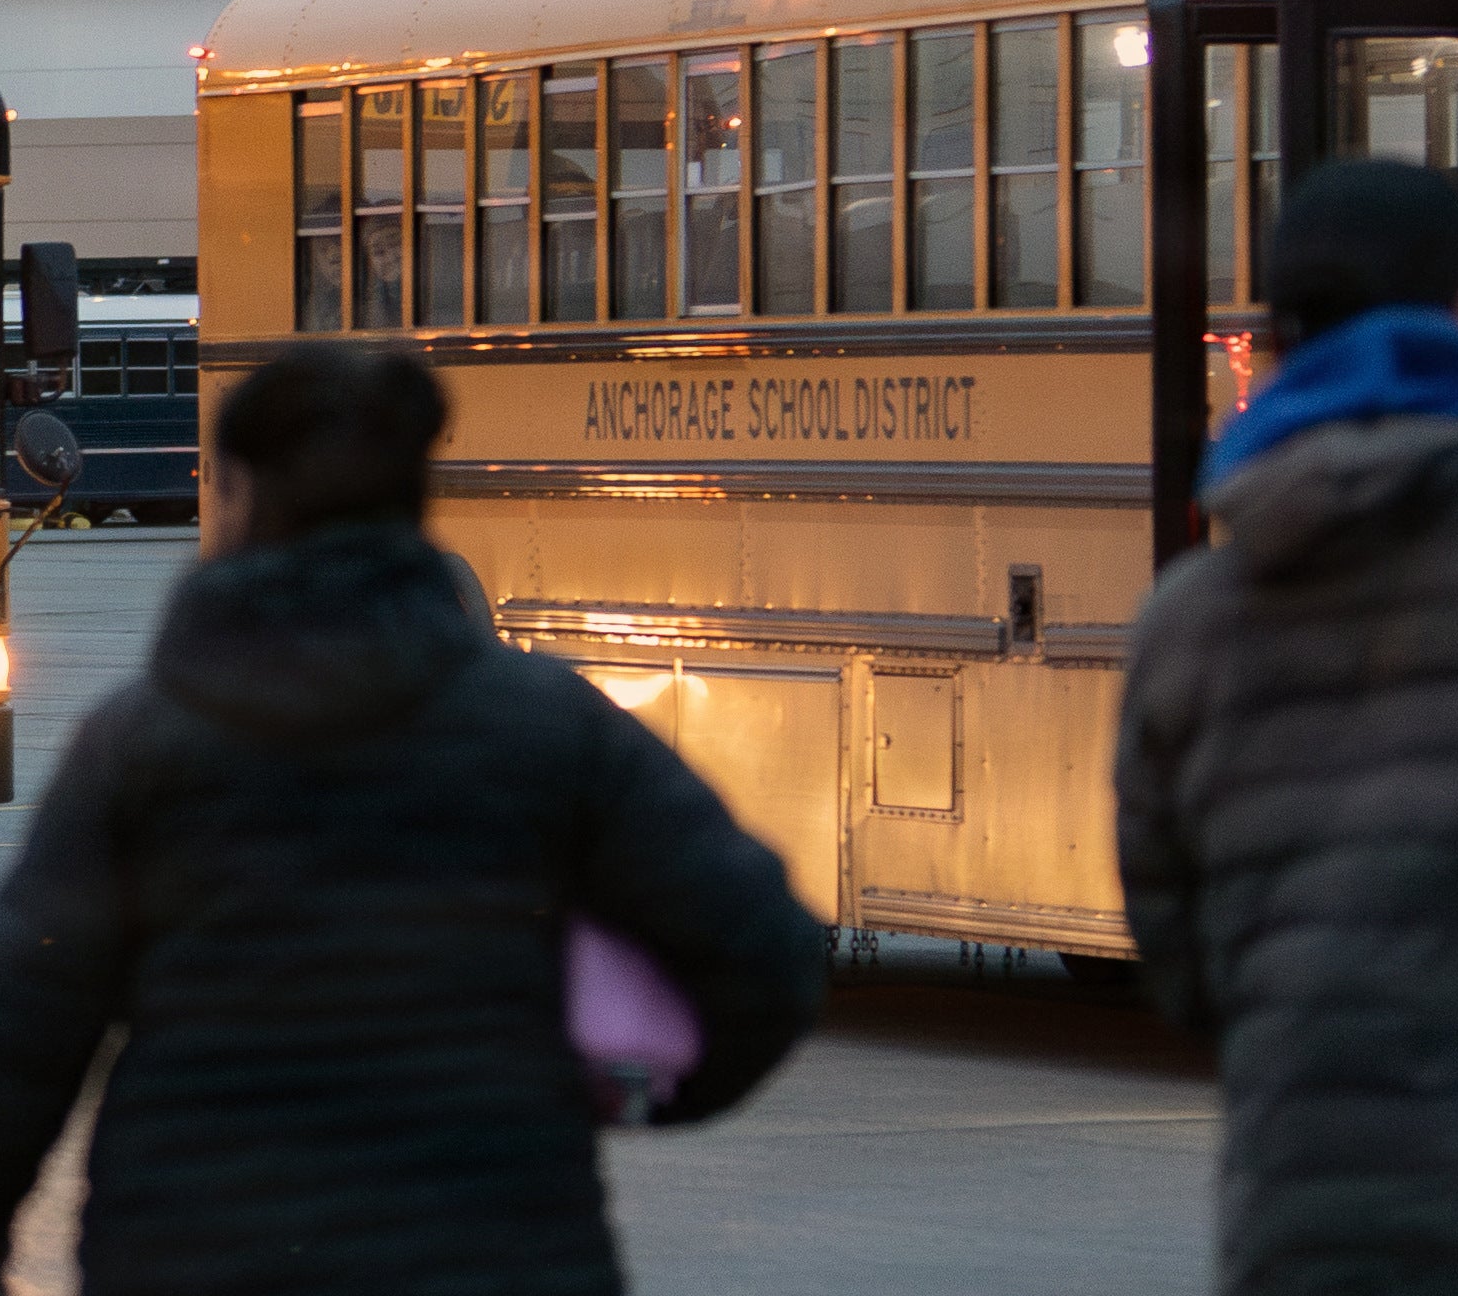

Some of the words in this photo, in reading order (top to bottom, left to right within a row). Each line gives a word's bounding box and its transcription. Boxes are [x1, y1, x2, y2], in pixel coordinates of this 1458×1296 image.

[585, 378, 736, 441] ANCHORAGE
[747, 377, 850, 441] SCHOOL
[854, 375, 976, 441] DISTRICT
